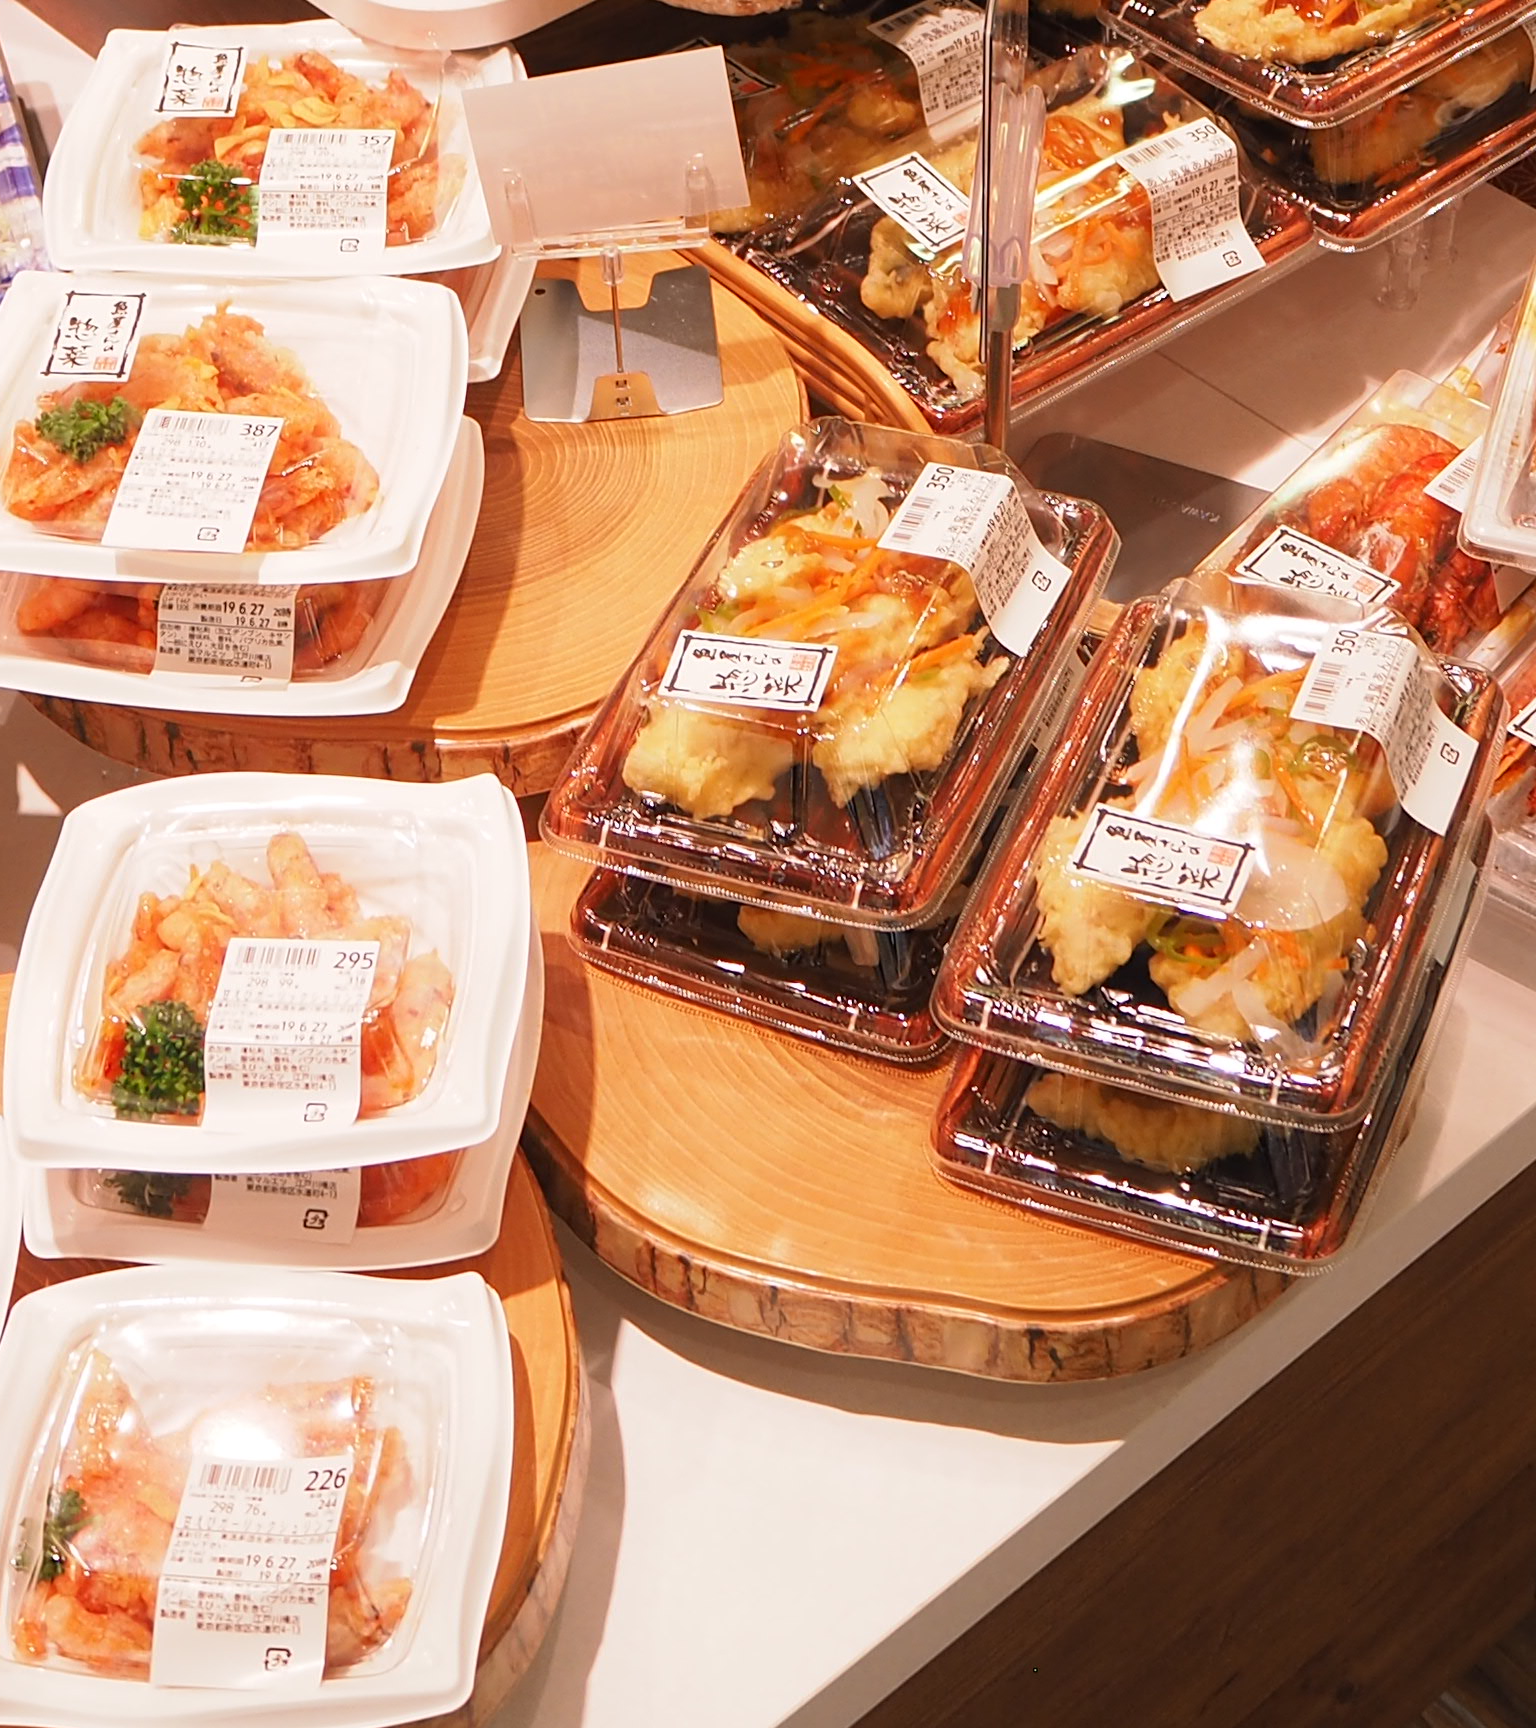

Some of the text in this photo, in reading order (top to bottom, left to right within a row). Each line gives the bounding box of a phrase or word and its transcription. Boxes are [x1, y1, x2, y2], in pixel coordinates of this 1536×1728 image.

[358, 134, 393, 147] 357
[1186, 124, 1218, 143] 350
[58, 316, 99, 368] 惣菜
[239, 422, 279, 439] 387
[926, 466, 956, 492] 350
[1331, 629, 1360, 657] 350
[333, 950, 376, 971] 295
[303, 1467, 348, 1493] 226
